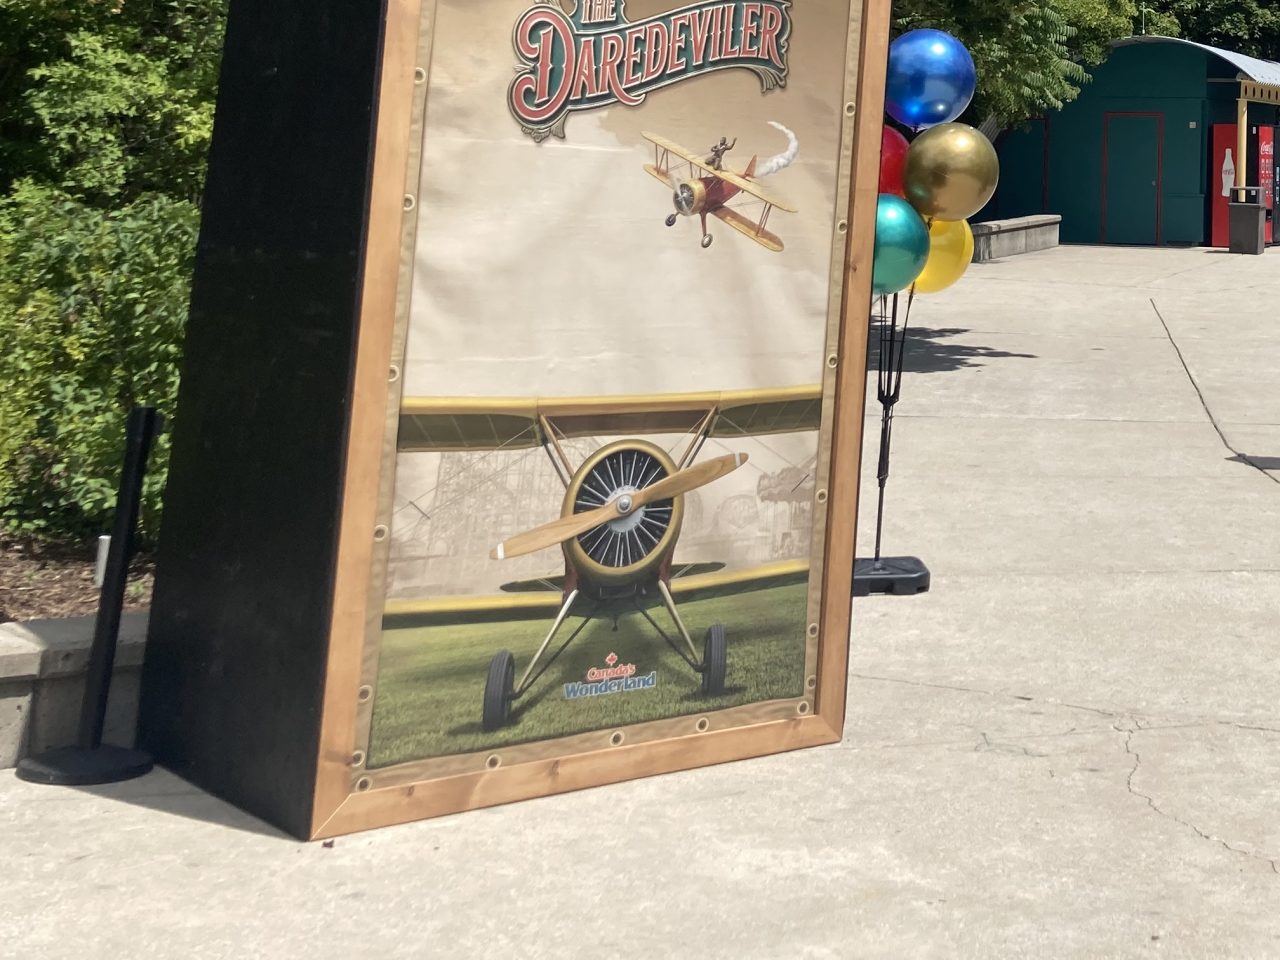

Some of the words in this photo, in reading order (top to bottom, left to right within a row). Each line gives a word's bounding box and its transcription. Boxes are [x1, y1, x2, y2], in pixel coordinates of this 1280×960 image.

[512, 4, 784, 120] DAREDEVILER
[565, 671, 656, 698] Wonderland
[587, 663, 636, 680] Canada's
